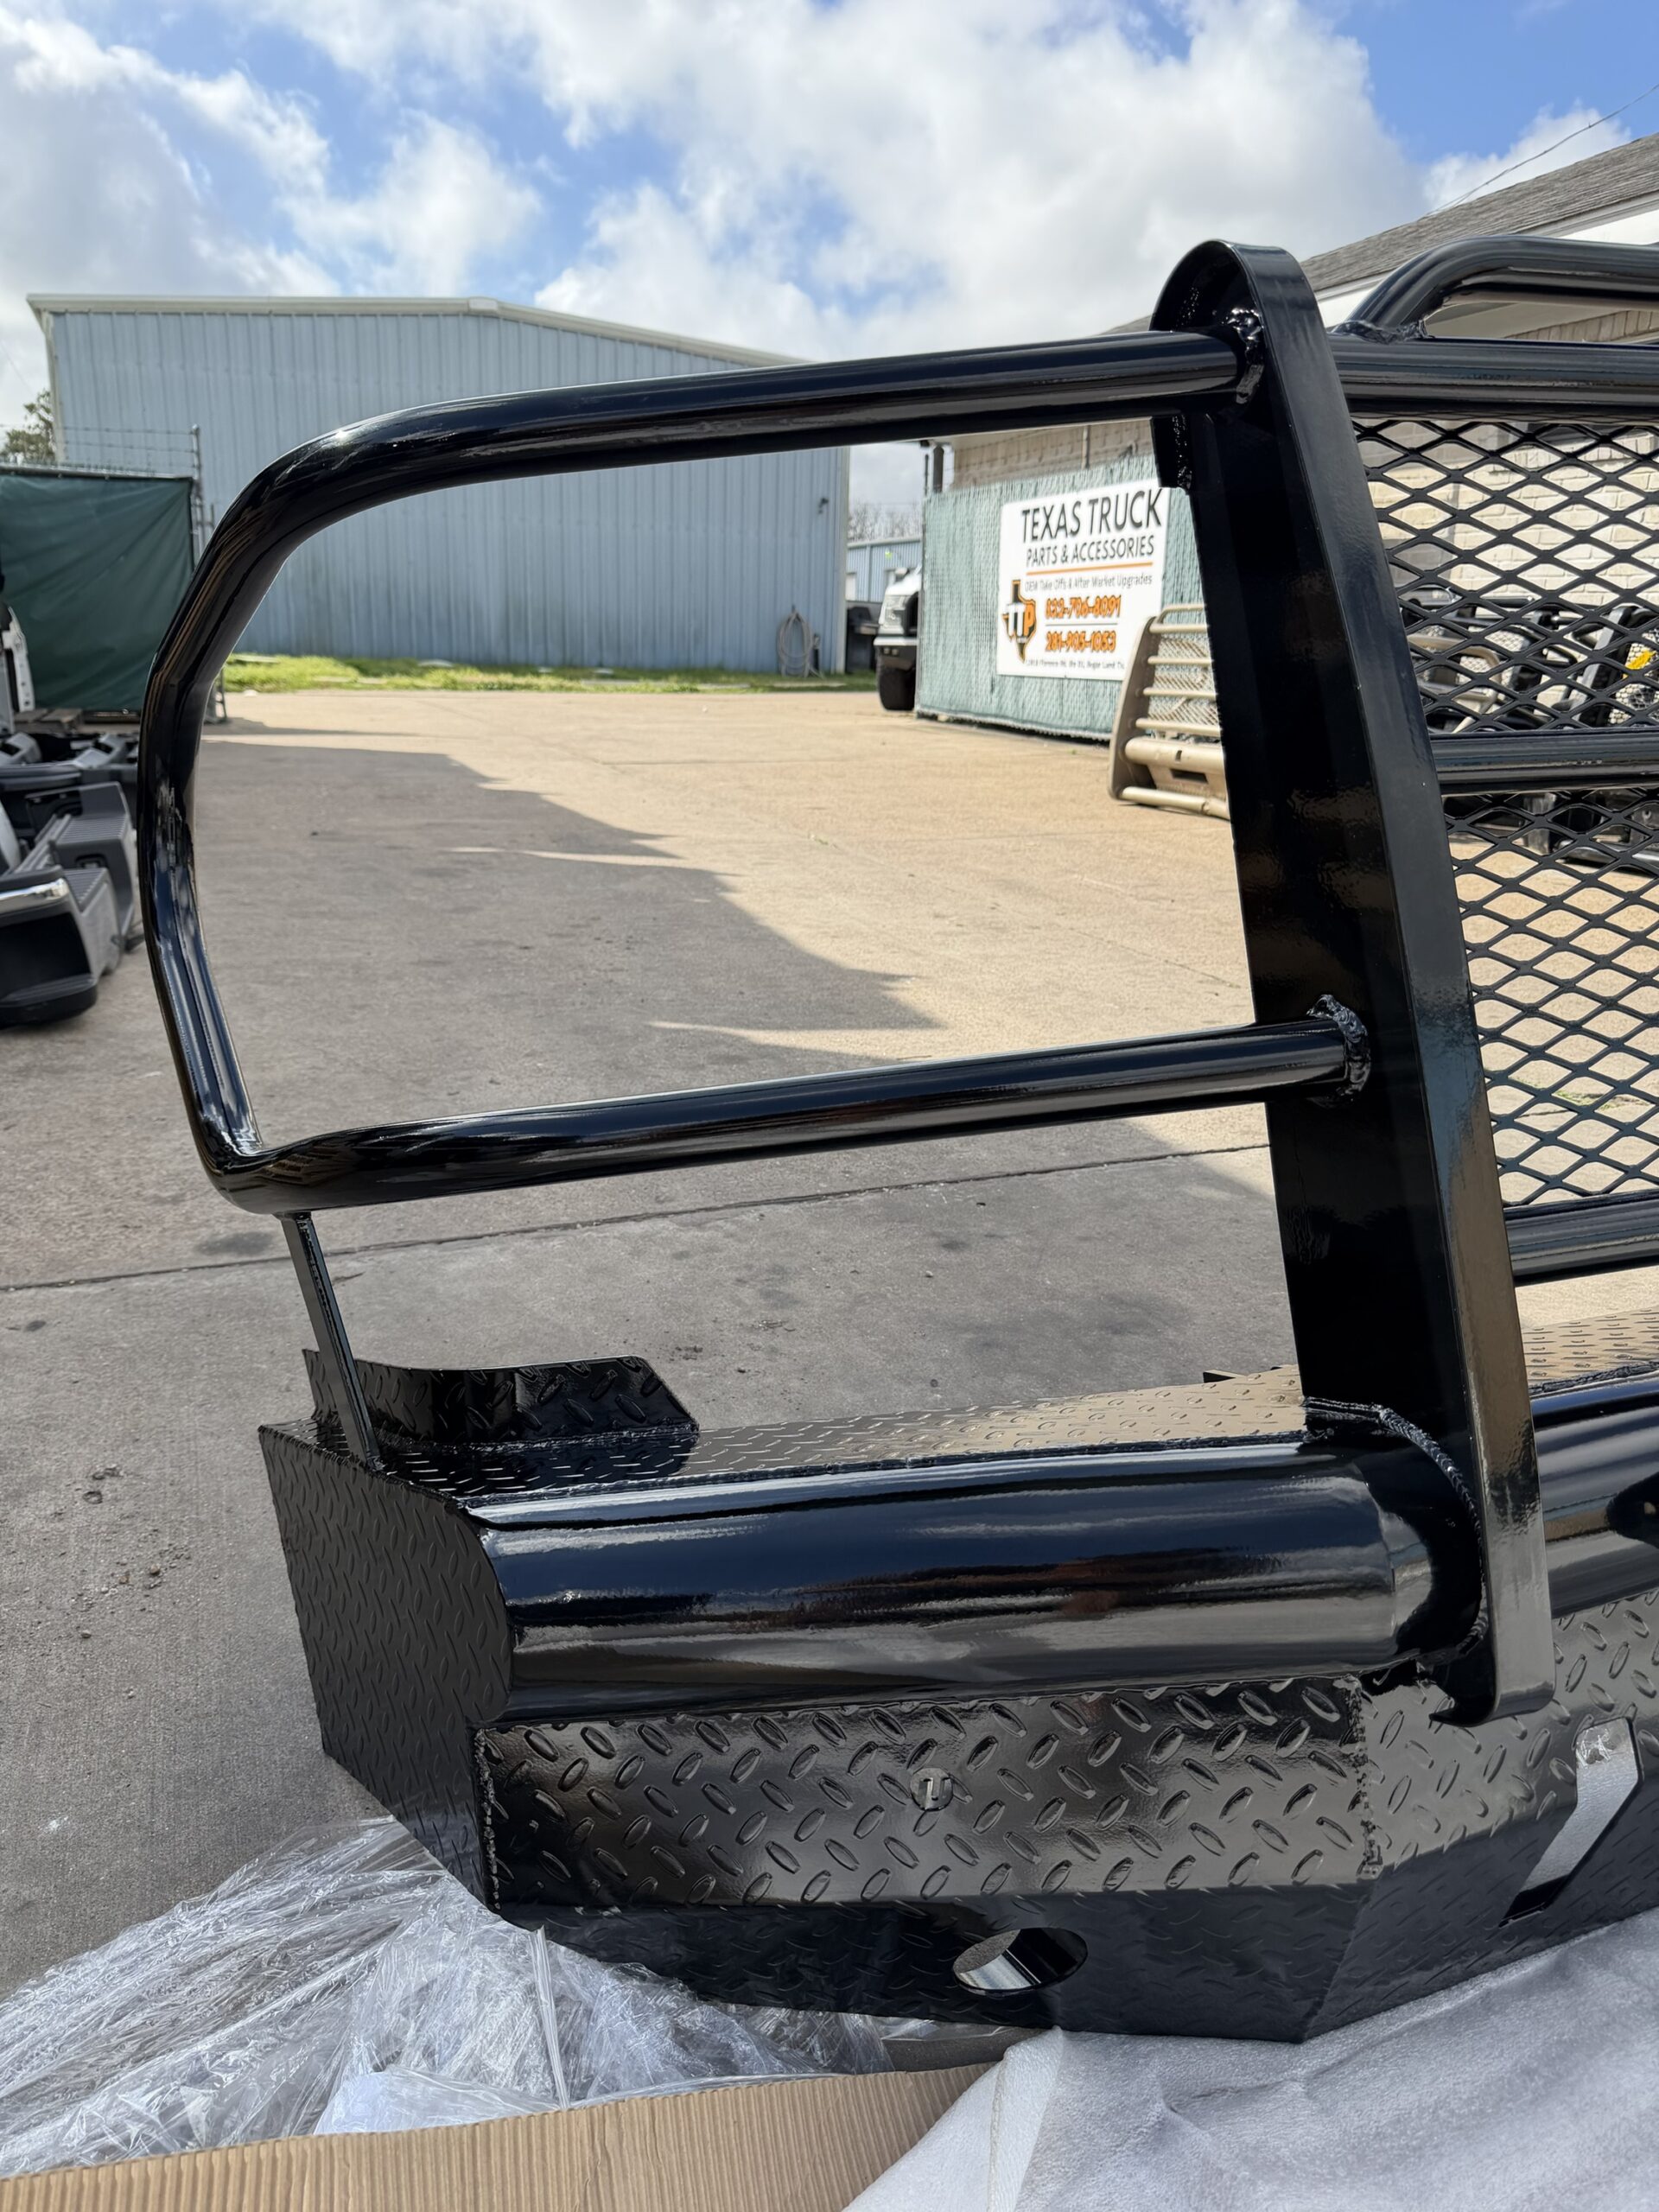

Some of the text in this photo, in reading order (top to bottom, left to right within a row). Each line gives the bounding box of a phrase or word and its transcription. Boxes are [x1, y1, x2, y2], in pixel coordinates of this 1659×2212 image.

[1021, 488, 1163, 543] TEXAS TRUCK
[1026, 535, 1154, 568] PARTS & ACCESSORIES
[1091, 575, 1116, 588] Market
[1117, 572, 1152, 589] Upgrades
